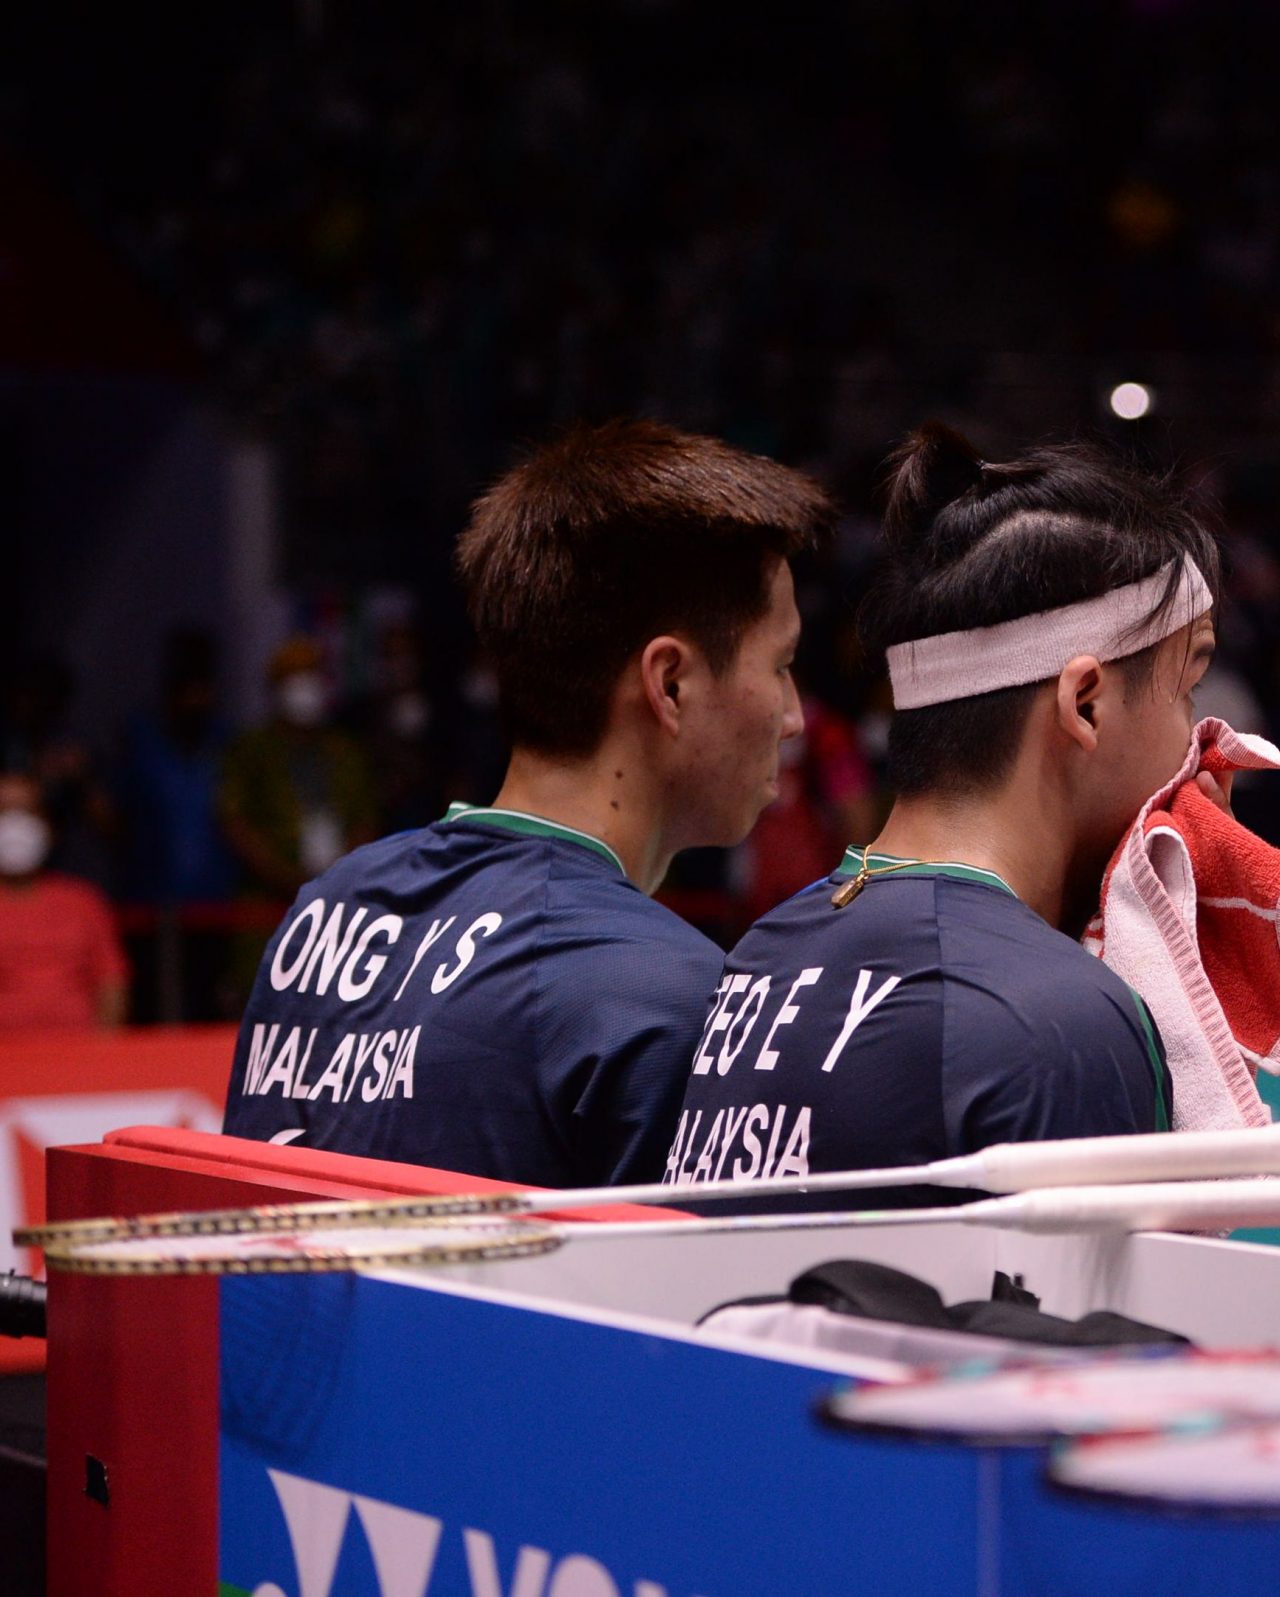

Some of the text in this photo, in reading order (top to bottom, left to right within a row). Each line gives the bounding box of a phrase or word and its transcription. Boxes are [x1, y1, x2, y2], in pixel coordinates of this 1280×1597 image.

[270, 898, 502, 1002] ONG Y S
[242, 1024, 422, 1103] MALAYSIA
[754, 967, 824, 1071] E
[821, 969, 902, 1073] Y
[661, 1103, 811, 1193] ALAYSIA
